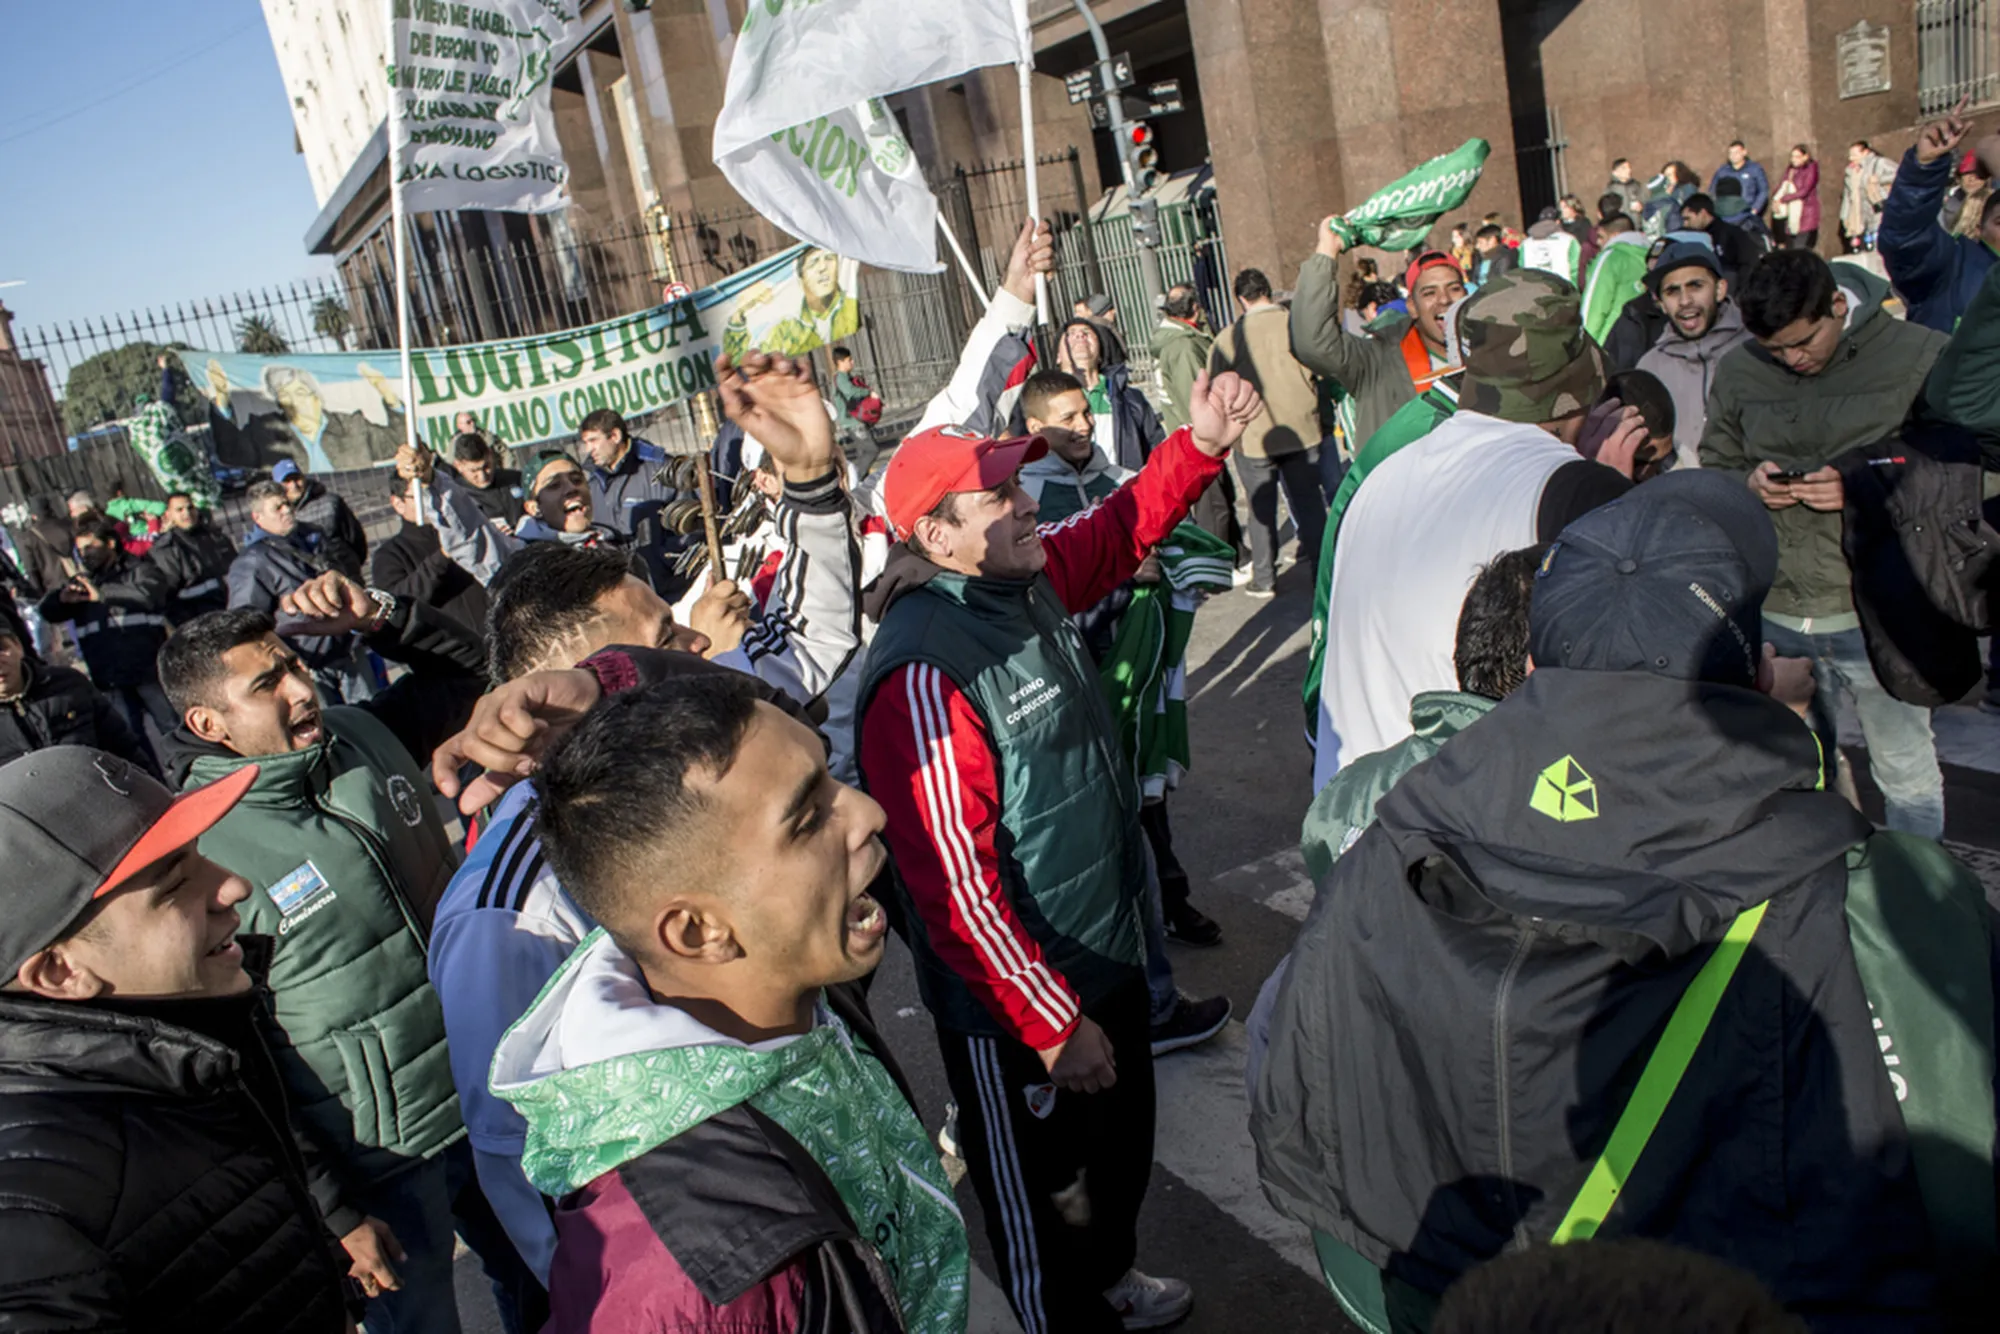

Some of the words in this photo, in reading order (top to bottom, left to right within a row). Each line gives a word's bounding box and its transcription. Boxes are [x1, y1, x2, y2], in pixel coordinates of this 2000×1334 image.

[450, 3, 469, 28] ME
[409, 31, 431, 56] DE
[481, 41, 500, 66] YO
[444, 70, 466, 93] LE
[410, 297, 709, 406] LOGISTICA
[558, 348, 718, 431] CONDUCCION
